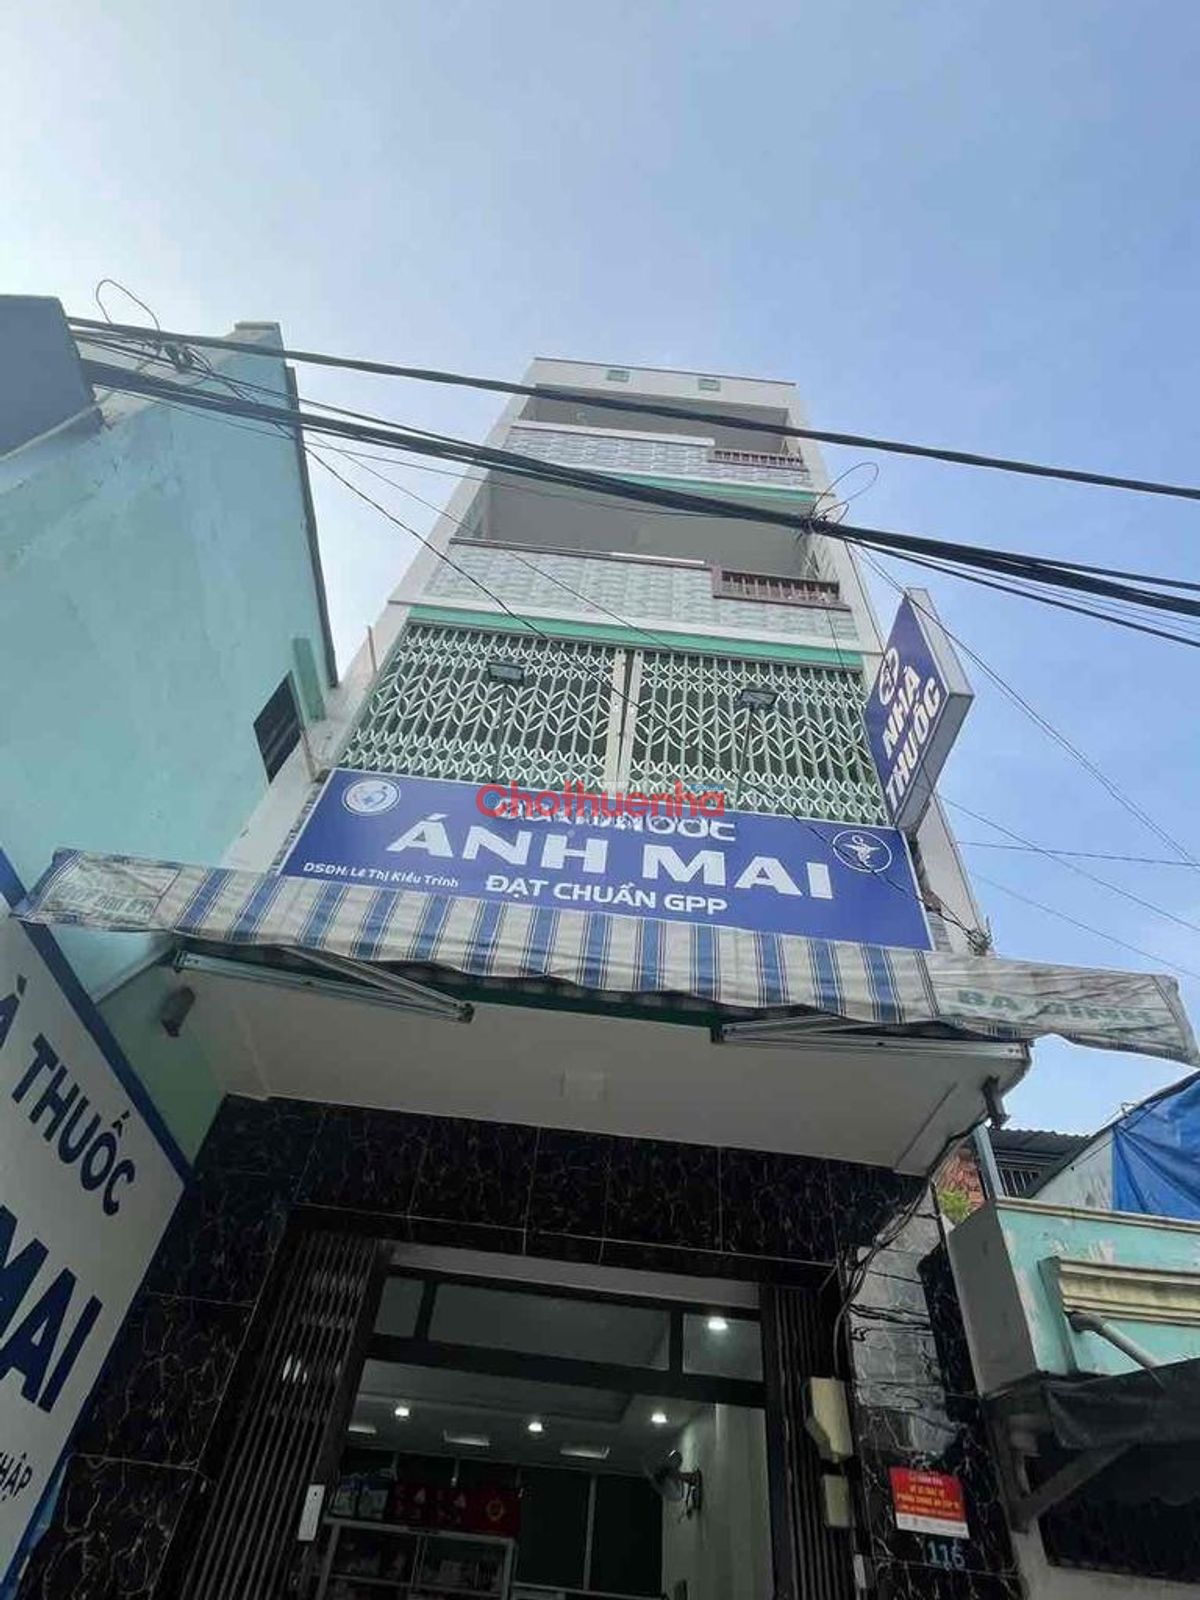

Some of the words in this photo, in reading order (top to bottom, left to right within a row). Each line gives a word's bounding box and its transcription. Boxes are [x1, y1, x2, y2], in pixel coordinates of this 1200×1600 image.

[386, 812, 609, 875] ÁNH
[641, 843, 834, 900] MAI
[485, 874, 549, 899] ĐẠT
[663, 893, 728, 916] GPP
[11, 1032, 136, 1216] THUỐC
[0, 1203, 103, 1413] MAI
